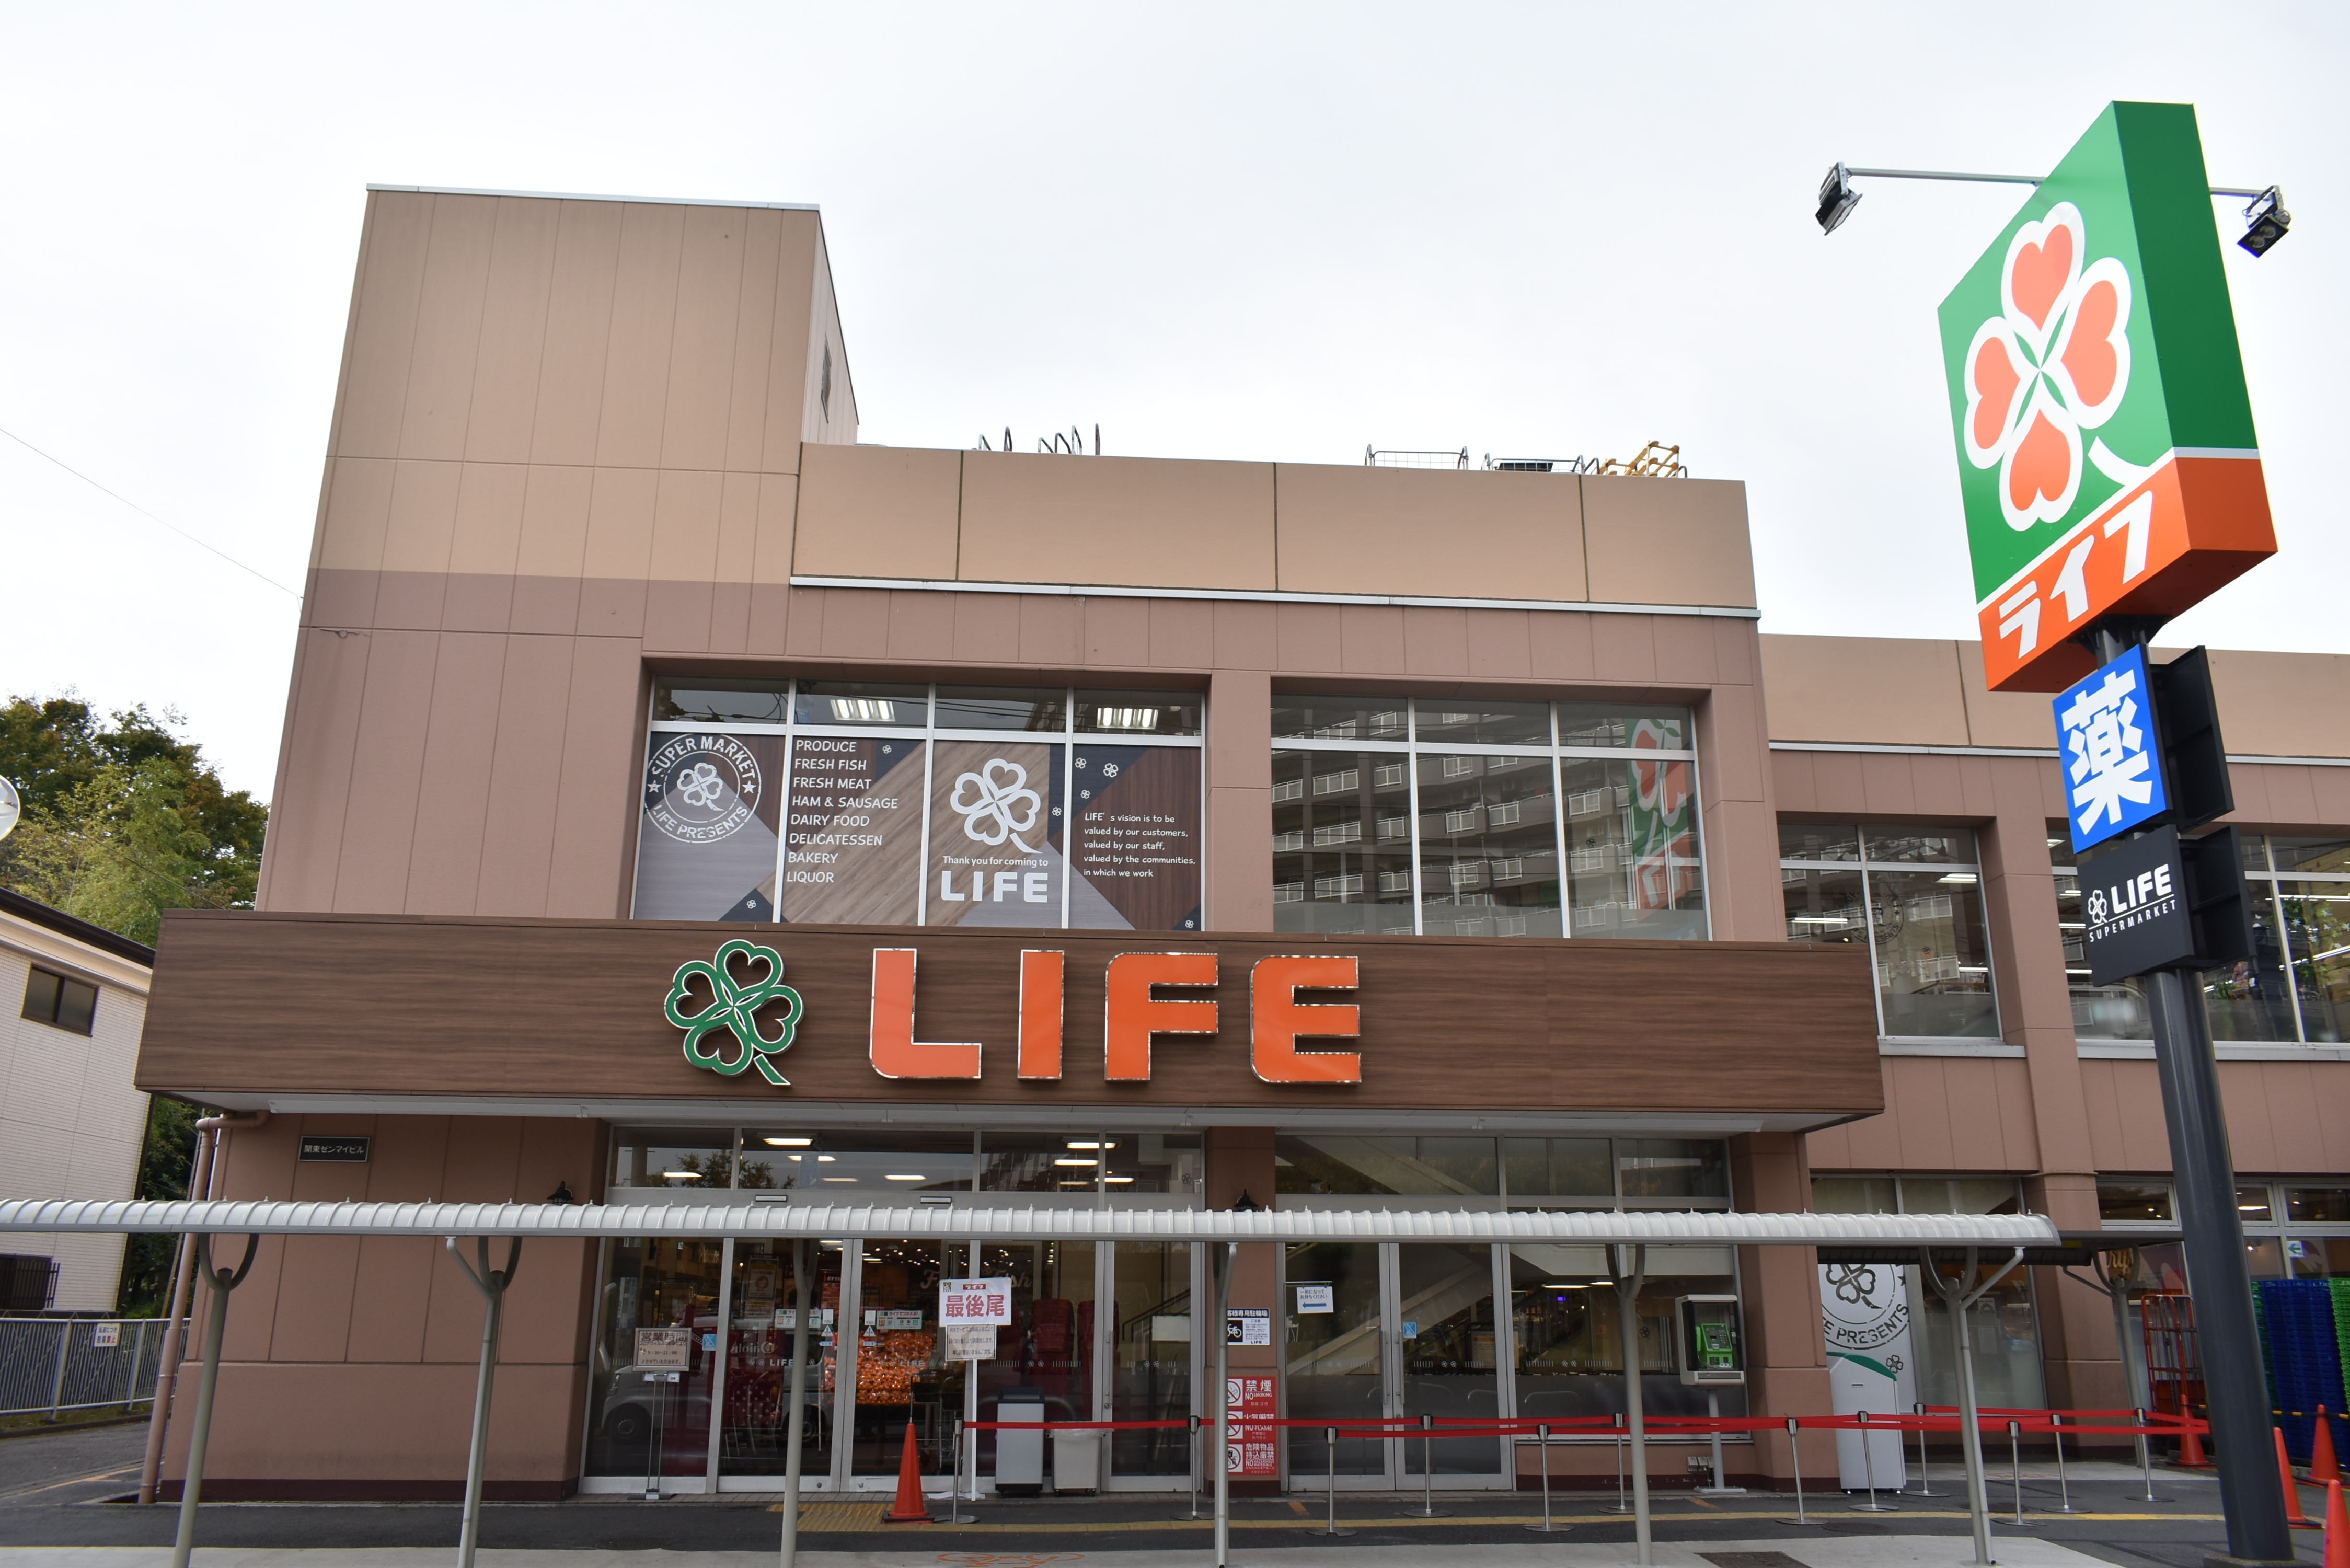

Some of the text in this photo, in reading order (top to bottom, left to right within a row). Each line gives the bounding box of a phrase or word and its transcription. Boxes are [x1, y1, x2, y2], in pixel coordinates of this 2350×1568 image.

[1999, 490, 2153, 659] ライフ
[796, 740, 857, 753] PRODUCE
[2061, 670, 2153, 835] 薬
[652, 735, 756, 779] SUPER MARKET
[794, 758, 867, 771] FRESH FISH
[793, 777, 872, 790] FRESH MEAT
[792, 795, 898, 809] HAM & SAUSAGE
[651, 803, 748, 839] LIFE PRESENTS
[790, 814, 870, 827] DAIRY FOOD
[1118, 813, 1141, 822] vision
[1165, 814, 1175, 823] be
[1084, 827, 1111, 835] valued
[1113, 827, 1123, 838] by
[1142, 828, 1188, 838] customers,
[789, 833, 883, 846] DELICATESSEN
[1084, 840, 1111, 849] valued
[1113, 841, 1123, 852] by
[1142, 841, 1165, 851] staff,
[788, 852, 838, 864] BAKERY
[943, 856, 1049, 868] Thank you for coming to
[1084, 854, 1196, 866] valued by the communities,
[786, 871, 835, 883] LIQUOR
[1084, 868, 1091, 877] in
[1093, 869, 1116, 877] which
[1133, 869, 1154, 877] work
[941, 871, 1048, 903] LIFE
[2111, 864, 2171, 914] LIFE
[2089, 899, 2175, 942] SUPERMARKET
[869, 948, 1361, 1085] LIFE
[304, 1145, 364, 1154] 関東ゼンマイビル
[946, 1294, 1004, 1317] 最後尾
[1836, 1304, 1909, 1344] PRESENTS
[641, 1332, 688, 1341] 営業時間
[1246, 1380, 1272, 1391] 禁煙
